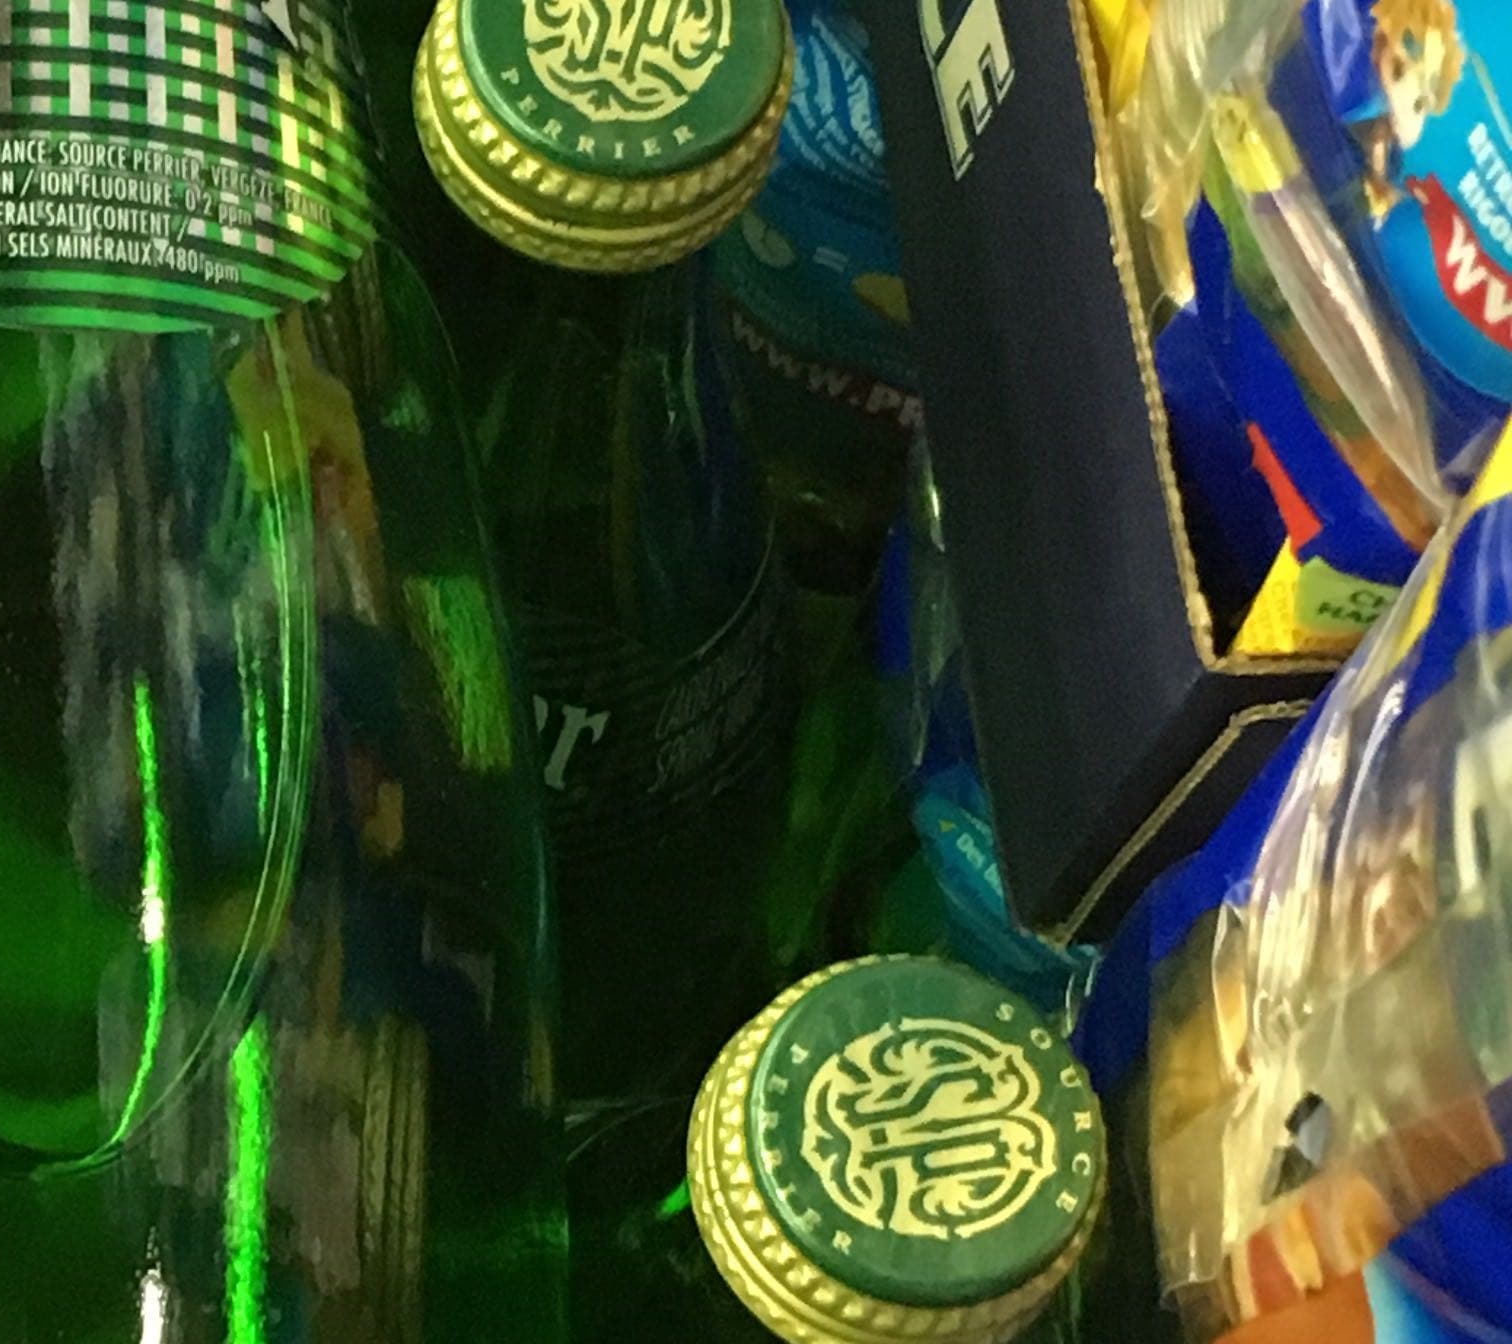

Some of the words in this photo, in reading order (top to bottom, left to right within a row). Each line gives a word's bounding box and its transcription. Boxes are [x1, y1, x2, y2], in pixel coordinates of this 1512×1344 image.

[500, 66, 696, 159] PERRIER
[59, 140, 127, 169] SOURCE
[40, 170, 74, 197] ION
[218, 203, 254, 227] ppm
[45, 202, 87, 228] SALT
[92, 205, 172, 238] CONTENT
[7, 232, 50, 259] SELS
[166, 244, 199, 275] 480
[203, 260, 241, 284] ppm
[996, 1002, 1092, 1215] SOURCE
